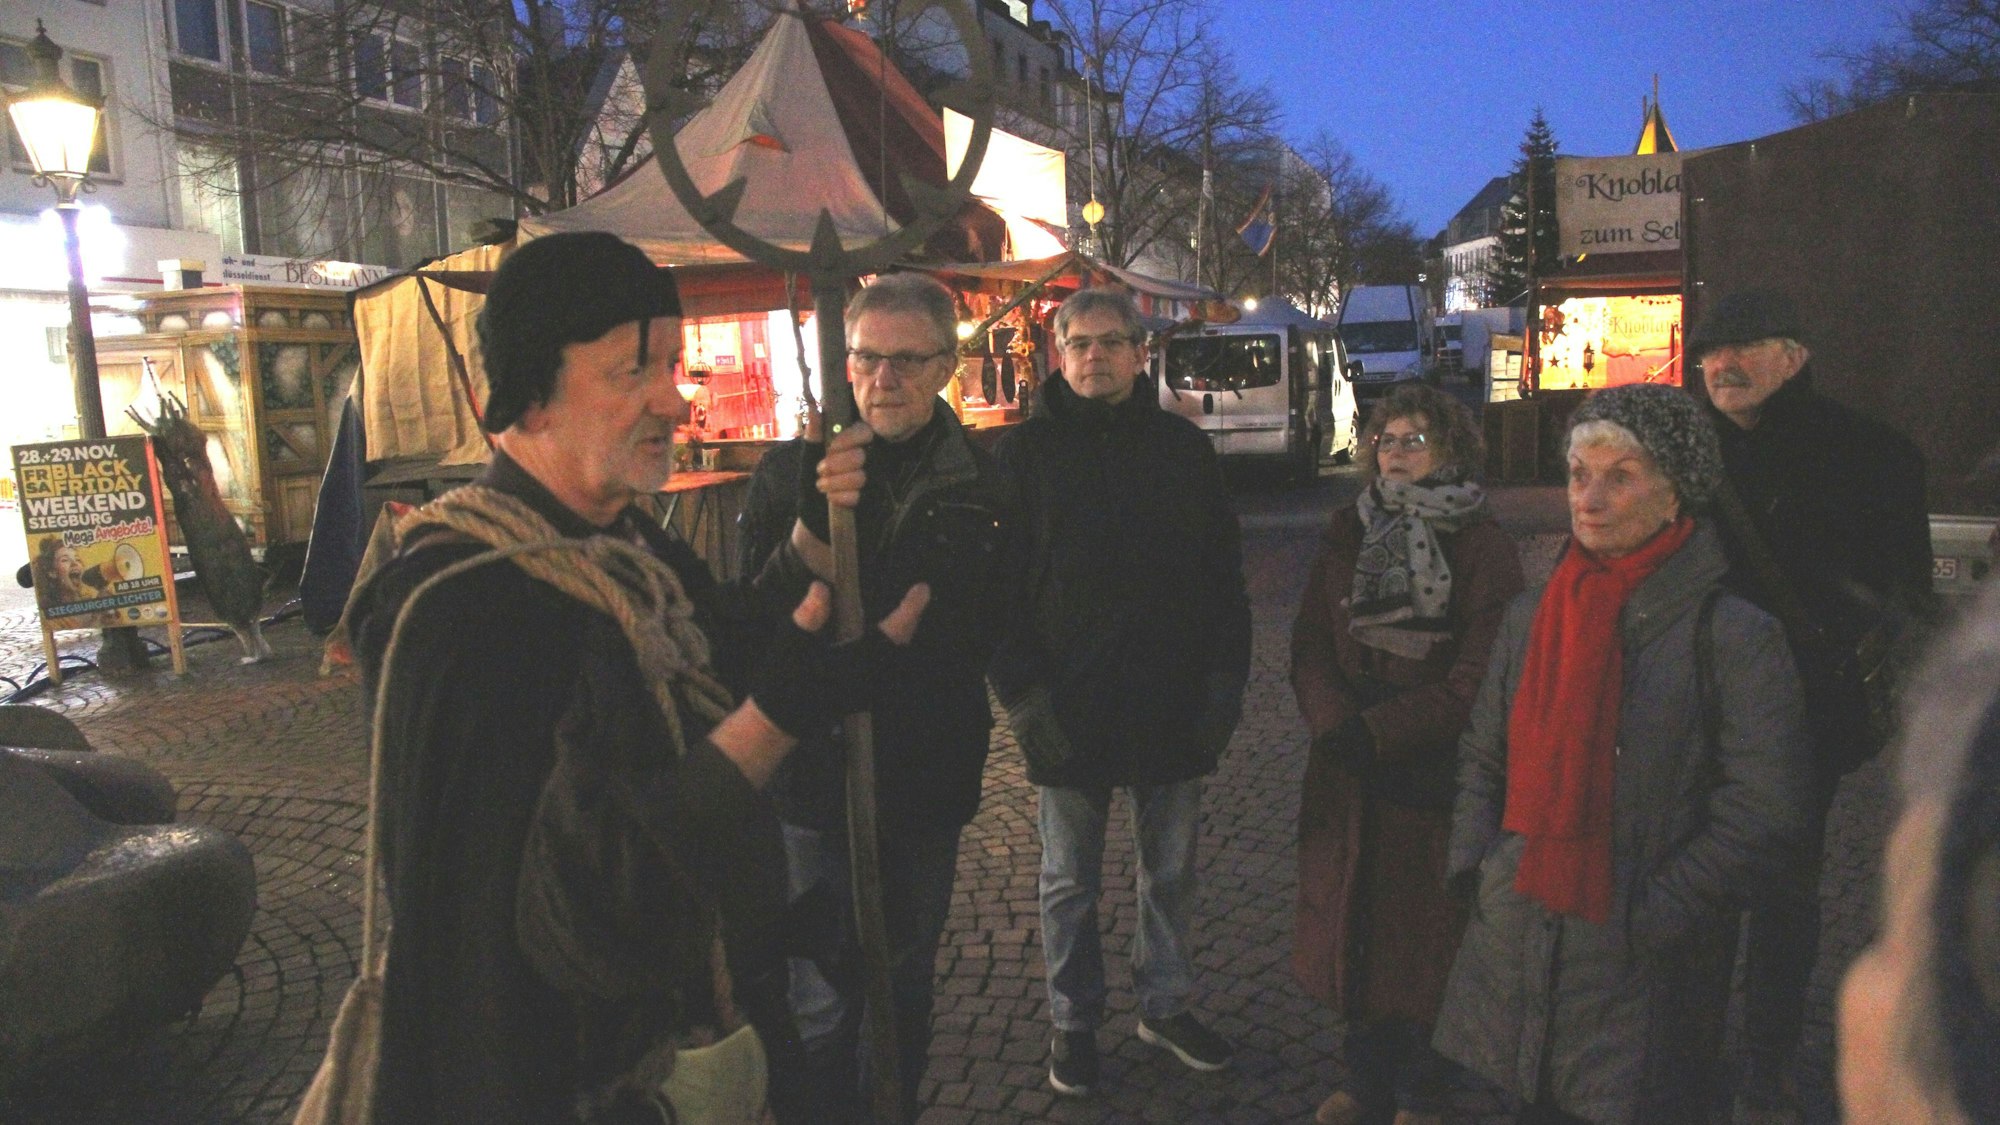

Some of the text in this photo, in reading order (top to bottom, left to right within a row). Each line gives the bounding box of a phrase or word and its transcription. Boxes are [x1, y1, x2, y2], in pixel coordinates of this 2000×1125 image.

[1576, 167, 1680, 202] Knobla
[1580, 227, 1634, 244] zum
[241, 258, 256, 267] und
[24, 468, 48, 481] FR
[51, 459, 131, 480] BLACK
[26, 482, 51, 494] SA
[54, 474, 142, 496] FRIDAY
[26, 491, 146, 517] WEEKEND
[28, 512, 113, 529] SIEGBURG
[64, 516, 153, 545] Mega Angebote!
[118, 583, 129, 591] AB
[141, 577, 160, 587] UHR
[48, 597, 117, 617] SIEGBURGER
[118, 590, 162, 606] LICHTER
